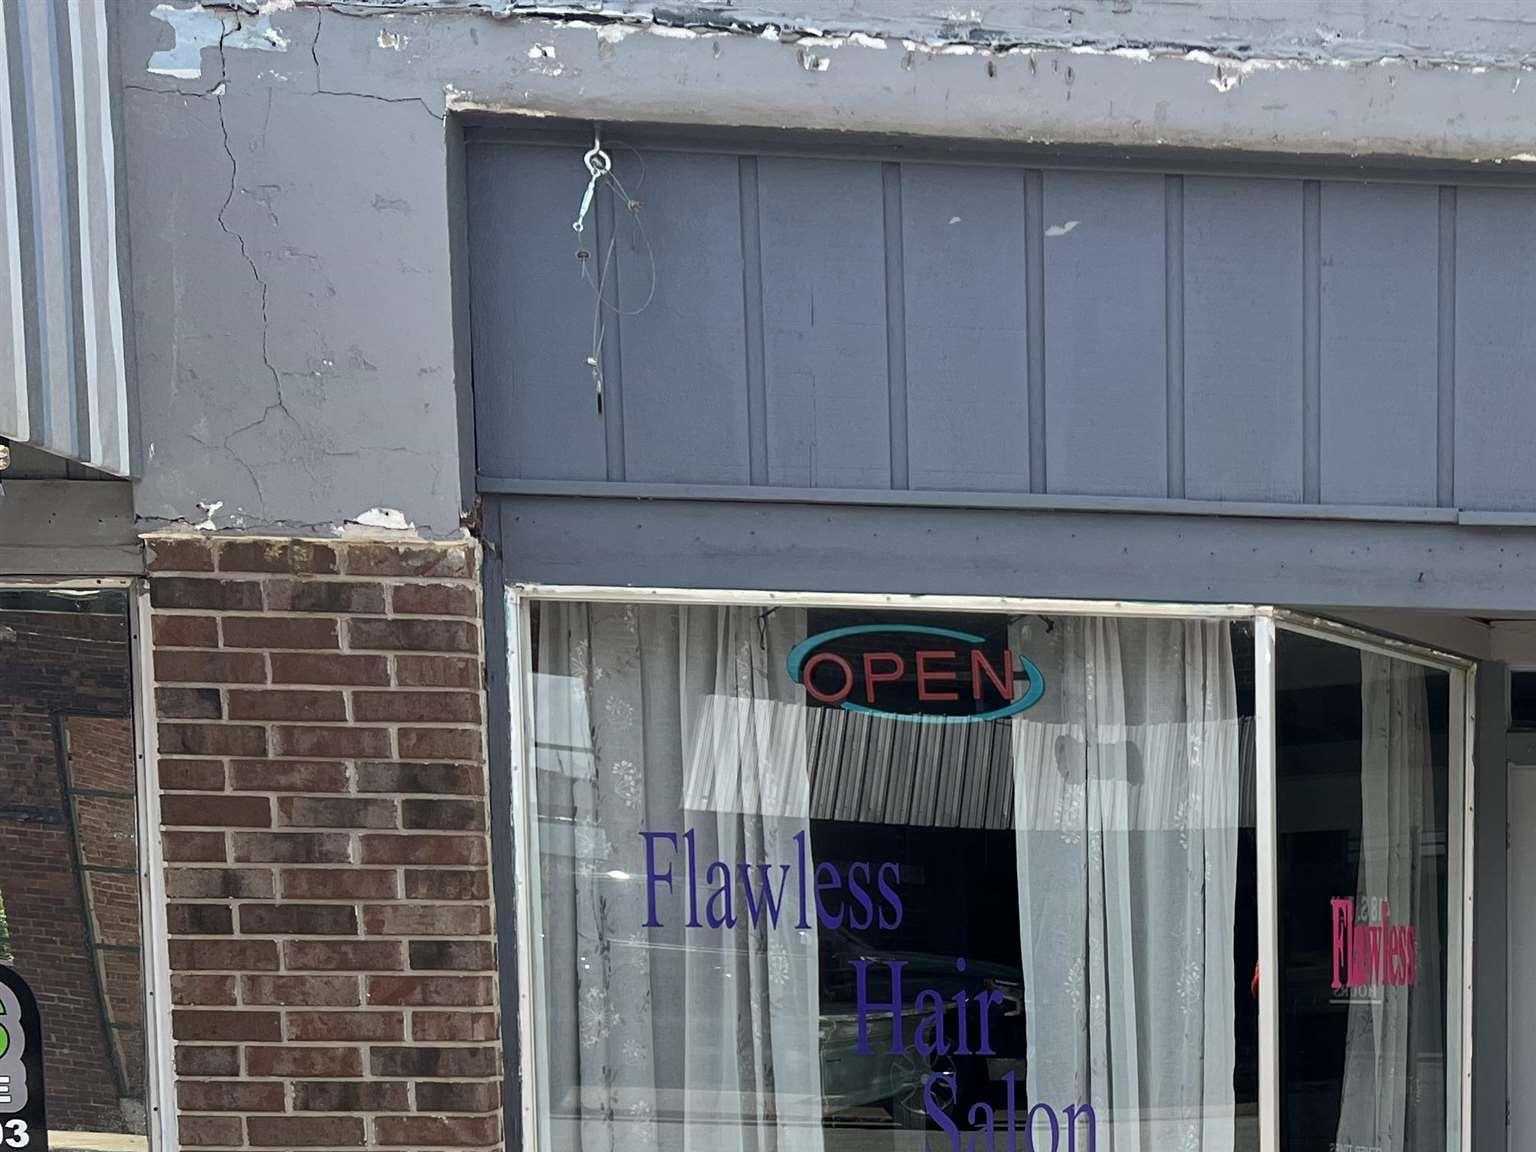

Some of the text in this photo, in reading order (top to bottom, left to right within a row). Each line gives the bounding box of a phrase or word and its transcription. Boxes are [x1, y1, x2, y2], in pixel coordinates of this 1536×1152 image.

[803, 649, 1015, 703] OPEN
[640, 829, 903, 930] Flawless
[1330, 898, 1417, 989] Flawless
[851, 957, 1002, 1057] Hair
